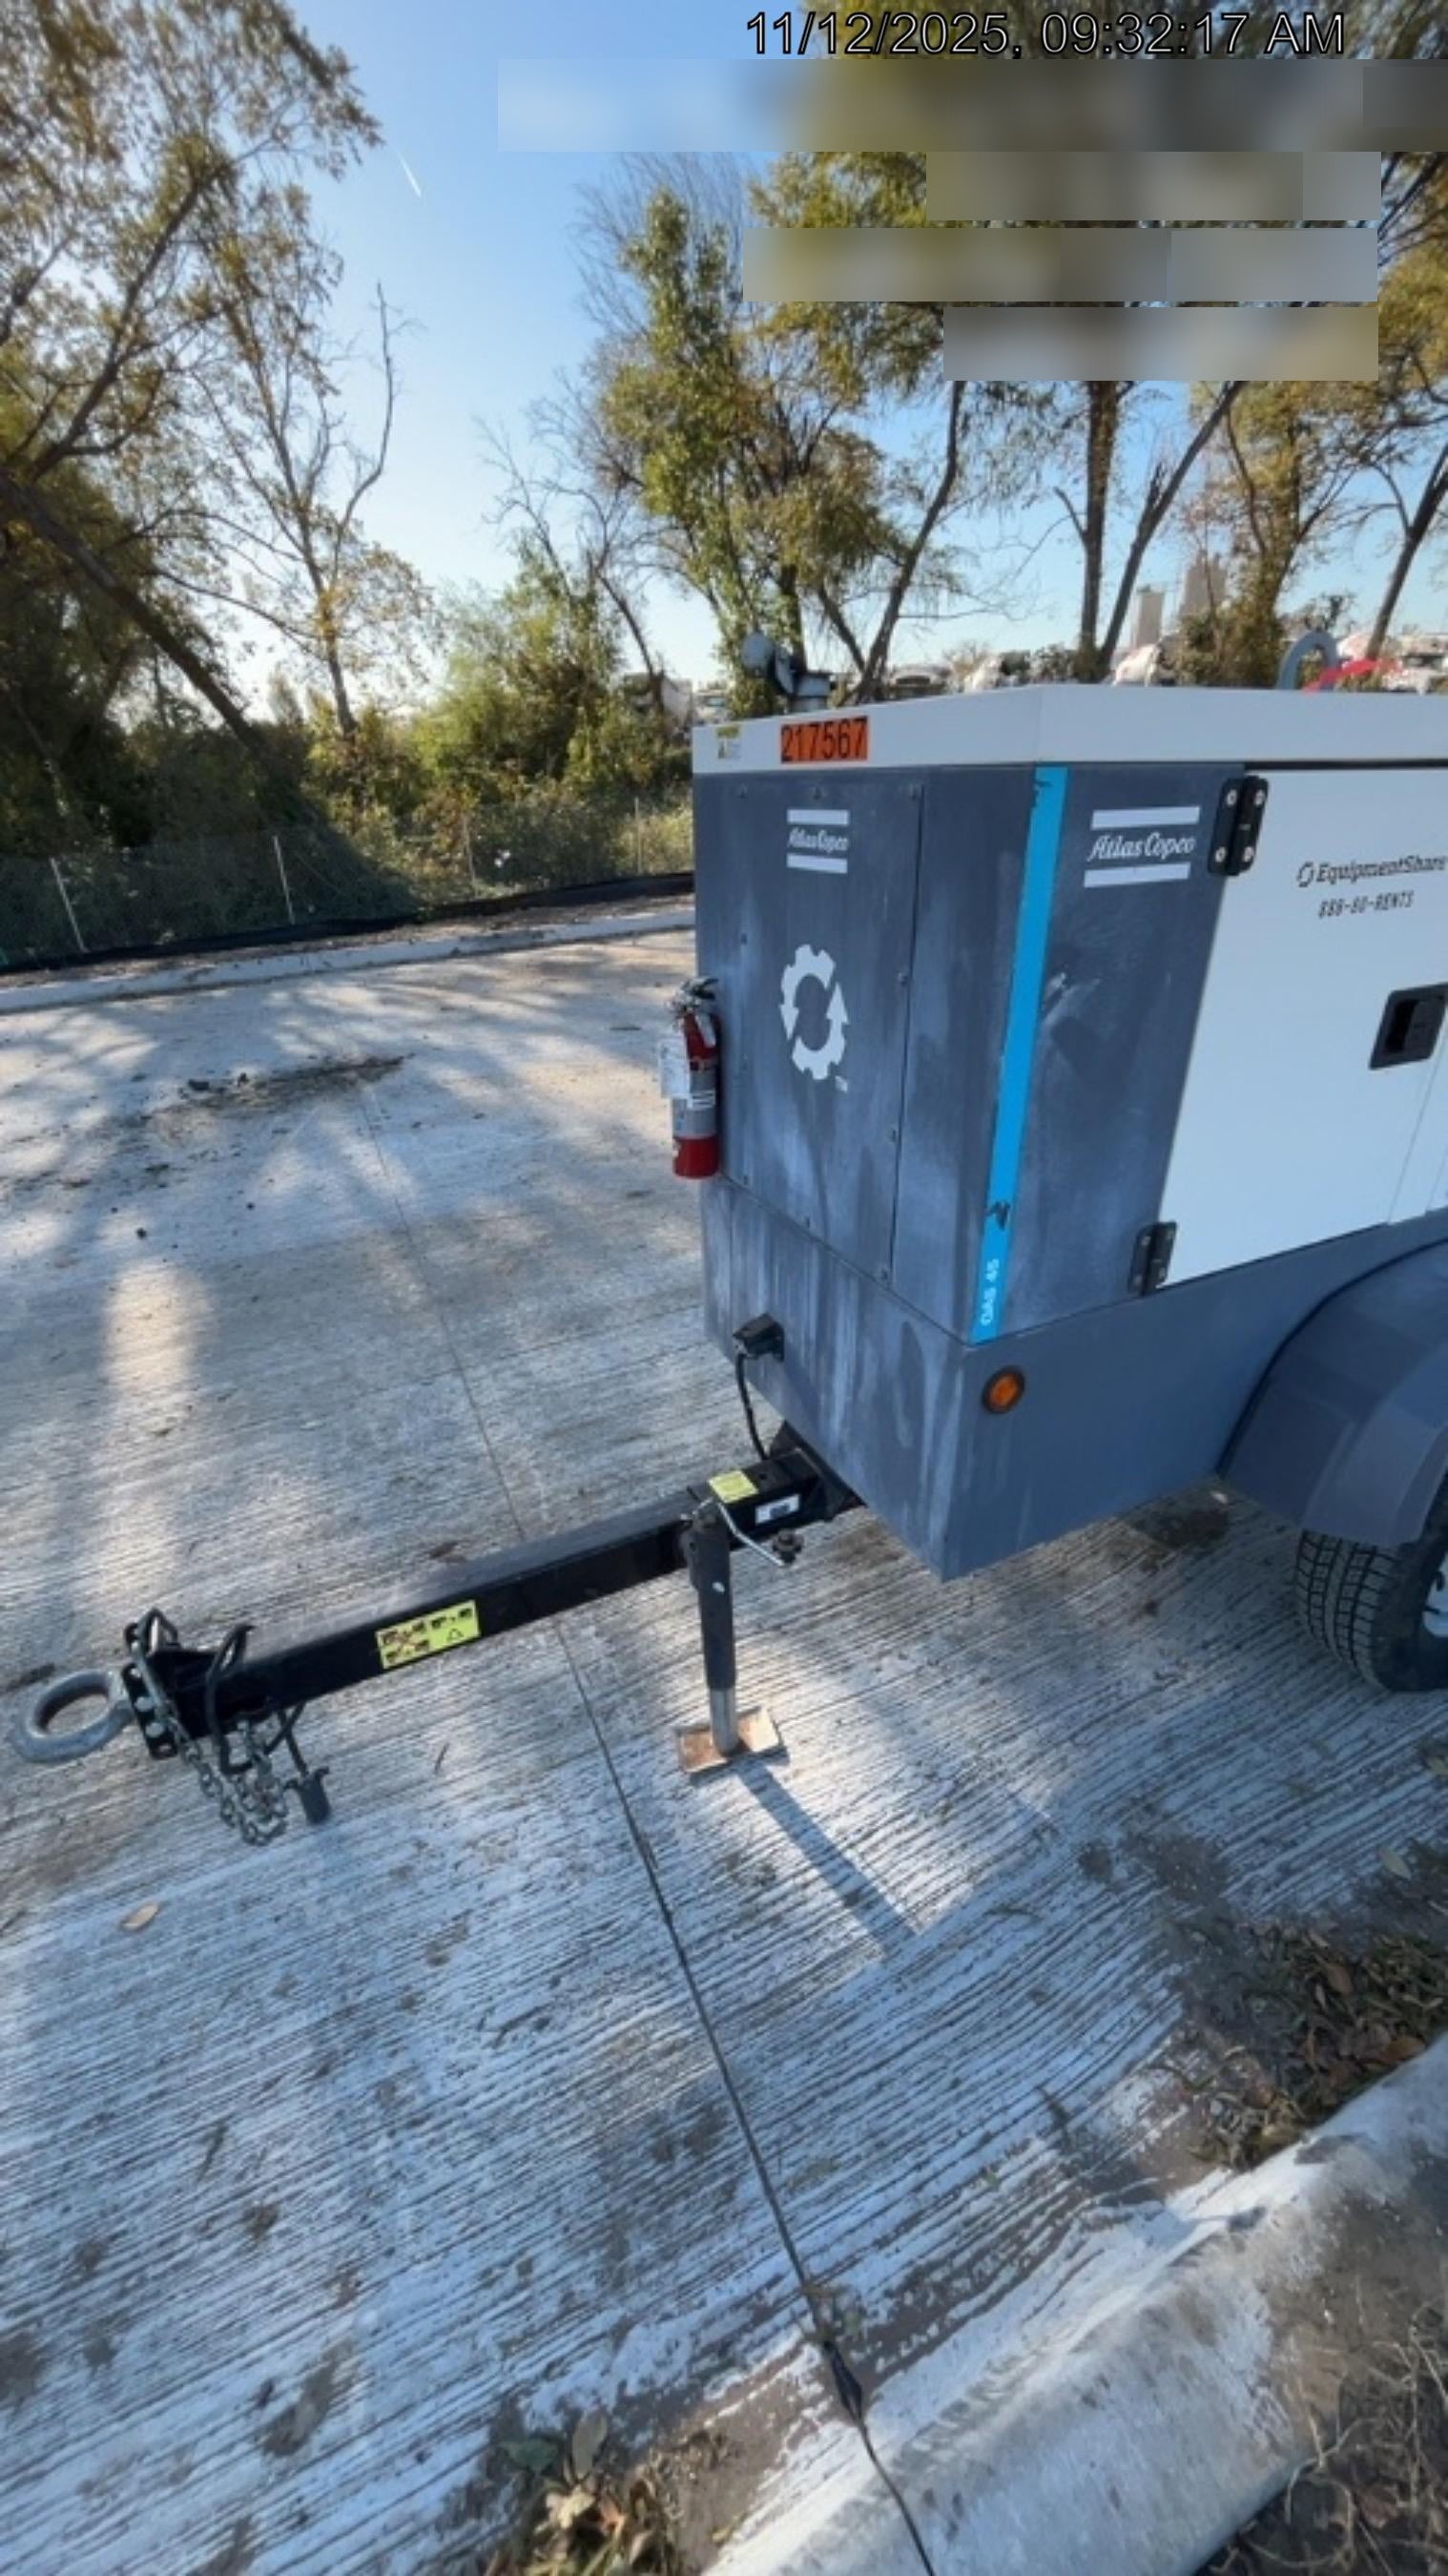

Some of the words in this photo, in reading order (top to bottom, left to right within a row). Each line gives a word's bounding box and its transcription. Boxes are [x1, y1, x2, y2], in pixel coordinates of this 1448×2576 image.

[781, 716, 868, 763] 217567
[788, 827, 817, 848] Atlas
[817, 829, 849, 853] Copco
[1088, 835, 1143, 862] Atlas
[1144, 832, 1195, 860] Copco
[1316, 855, 1448, 884] EquipmentShare
[1318, 890, 1415, 919] 888-80-RENTS
